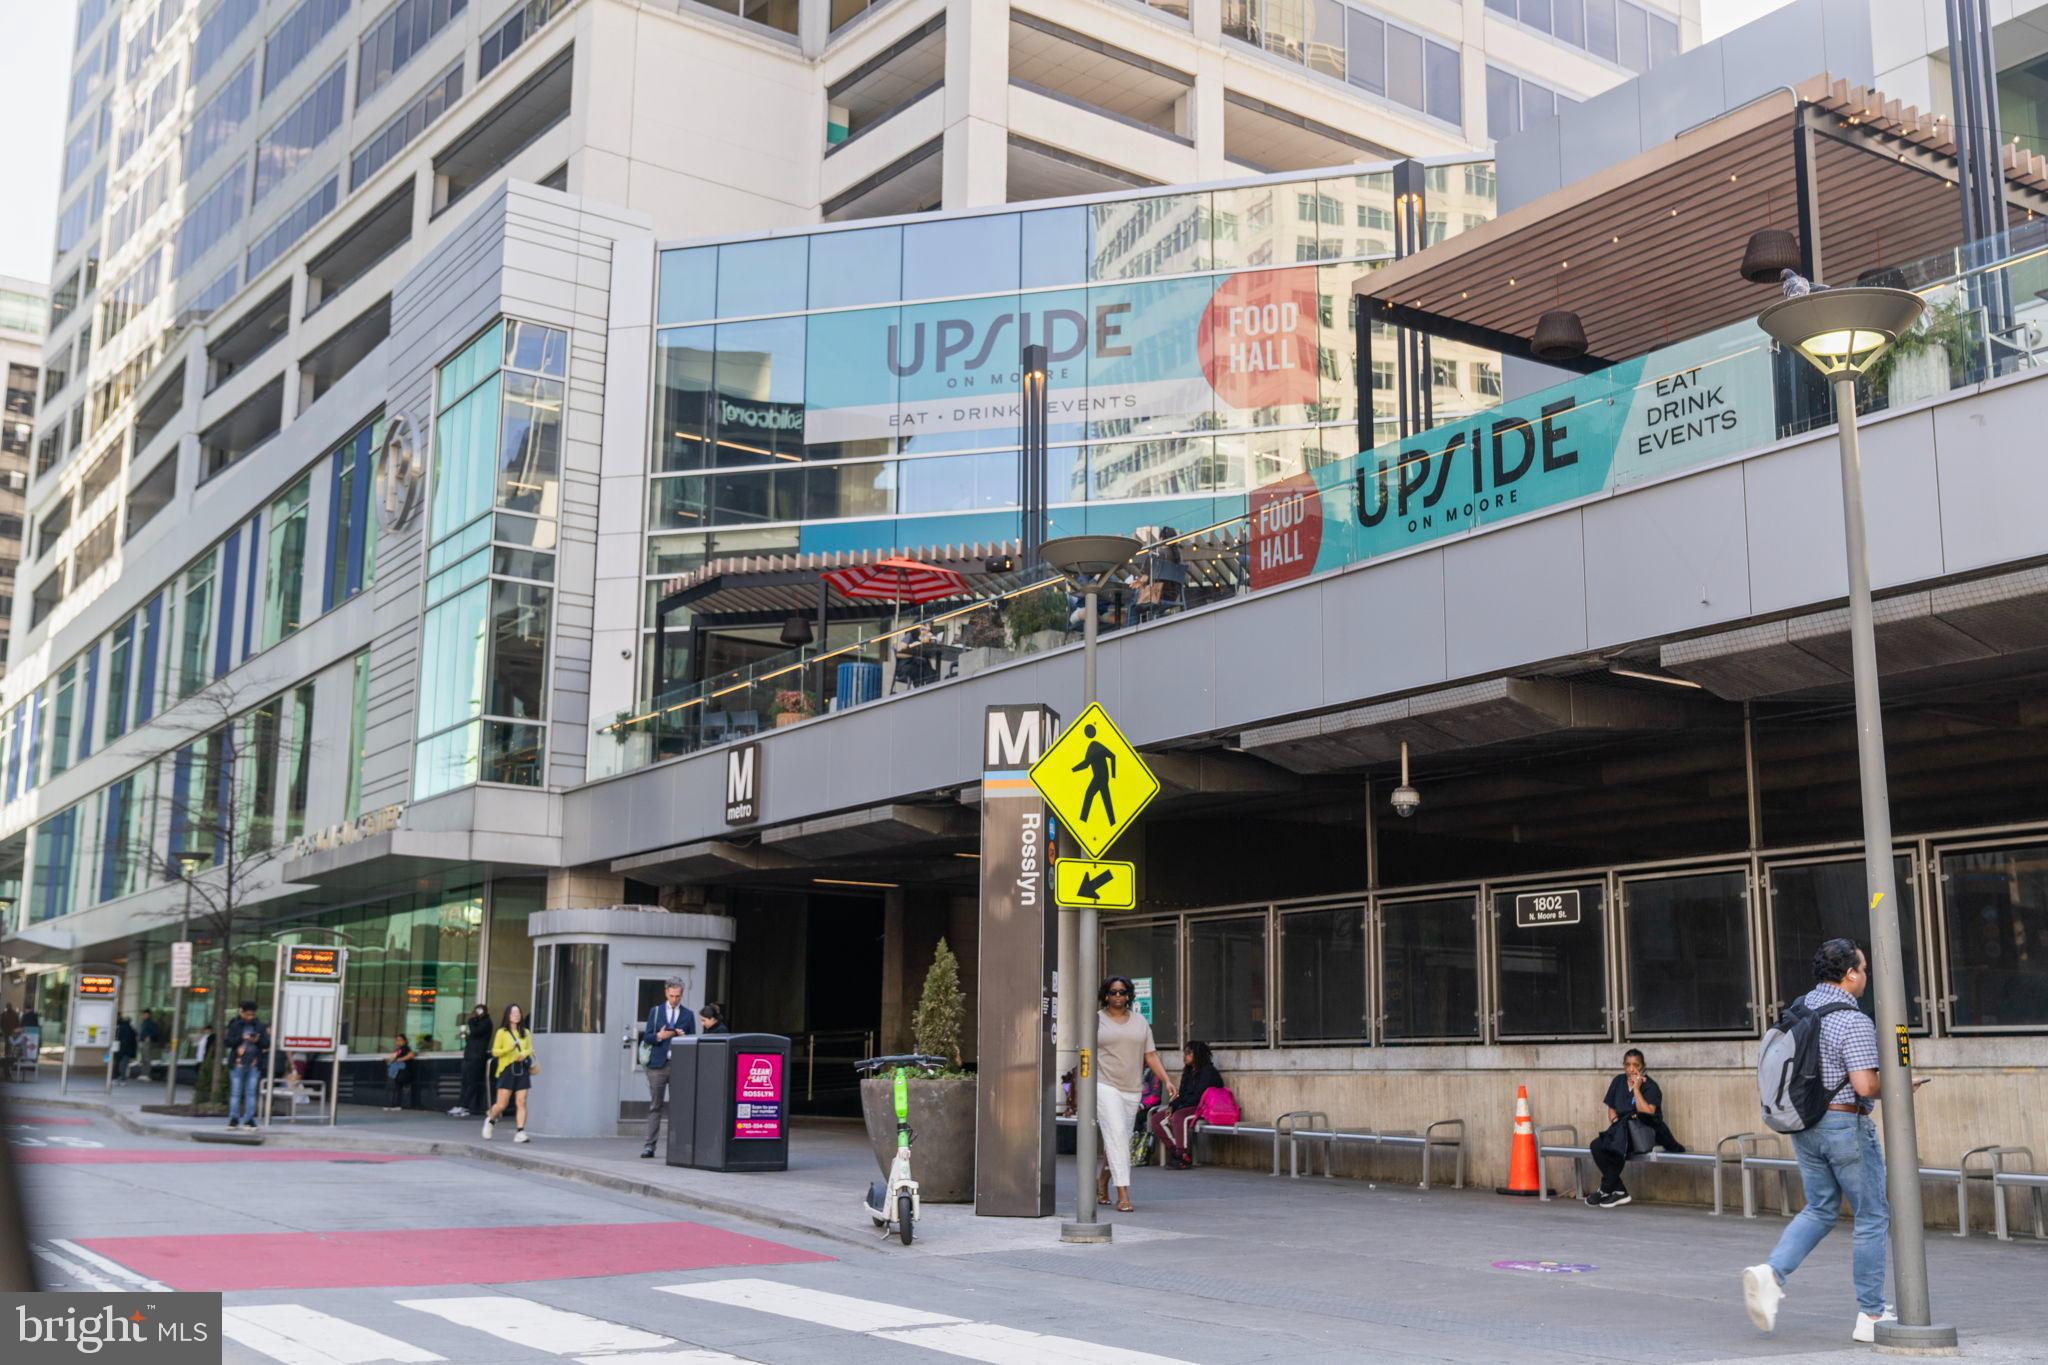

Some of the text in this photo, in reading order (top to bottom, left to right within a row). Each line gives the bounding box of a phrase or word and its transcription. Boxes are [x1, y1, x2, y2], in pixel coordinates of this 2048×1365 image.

[887, 303, 1132, 377] UPSIDE
[1229, 302, 1298, 338] FOOD
[1229, 338, 1295, 375] HALL
[947, 367, 1069, 388] ON MORE
[1656, 367, 1702, 398] EAT
[889, 394, 1136, 427] EAT DRINK EVENTS
[1647, 386, 1724, 427] DRINK
[1638, 409, 1737, 455] EVENTS
[1356, 396, 1578, 528] UPSIDE
[1259, 493, 1306, 535] FOOD
[1408, 489, 1518, 533] ON MOORE
[1260, 530, 1304, 571] HALL
[988, 711, 1040, 765] M
[728, 747, 754, 804] M
[727, 804, 752, 821] metro
[1016, 812, 1041, 906] Rosslyn
[1533, 895, 1562, 911] 1802
[1538, 911, 1556, 920] Moore
[1558, 910, 1567, 919] St.
